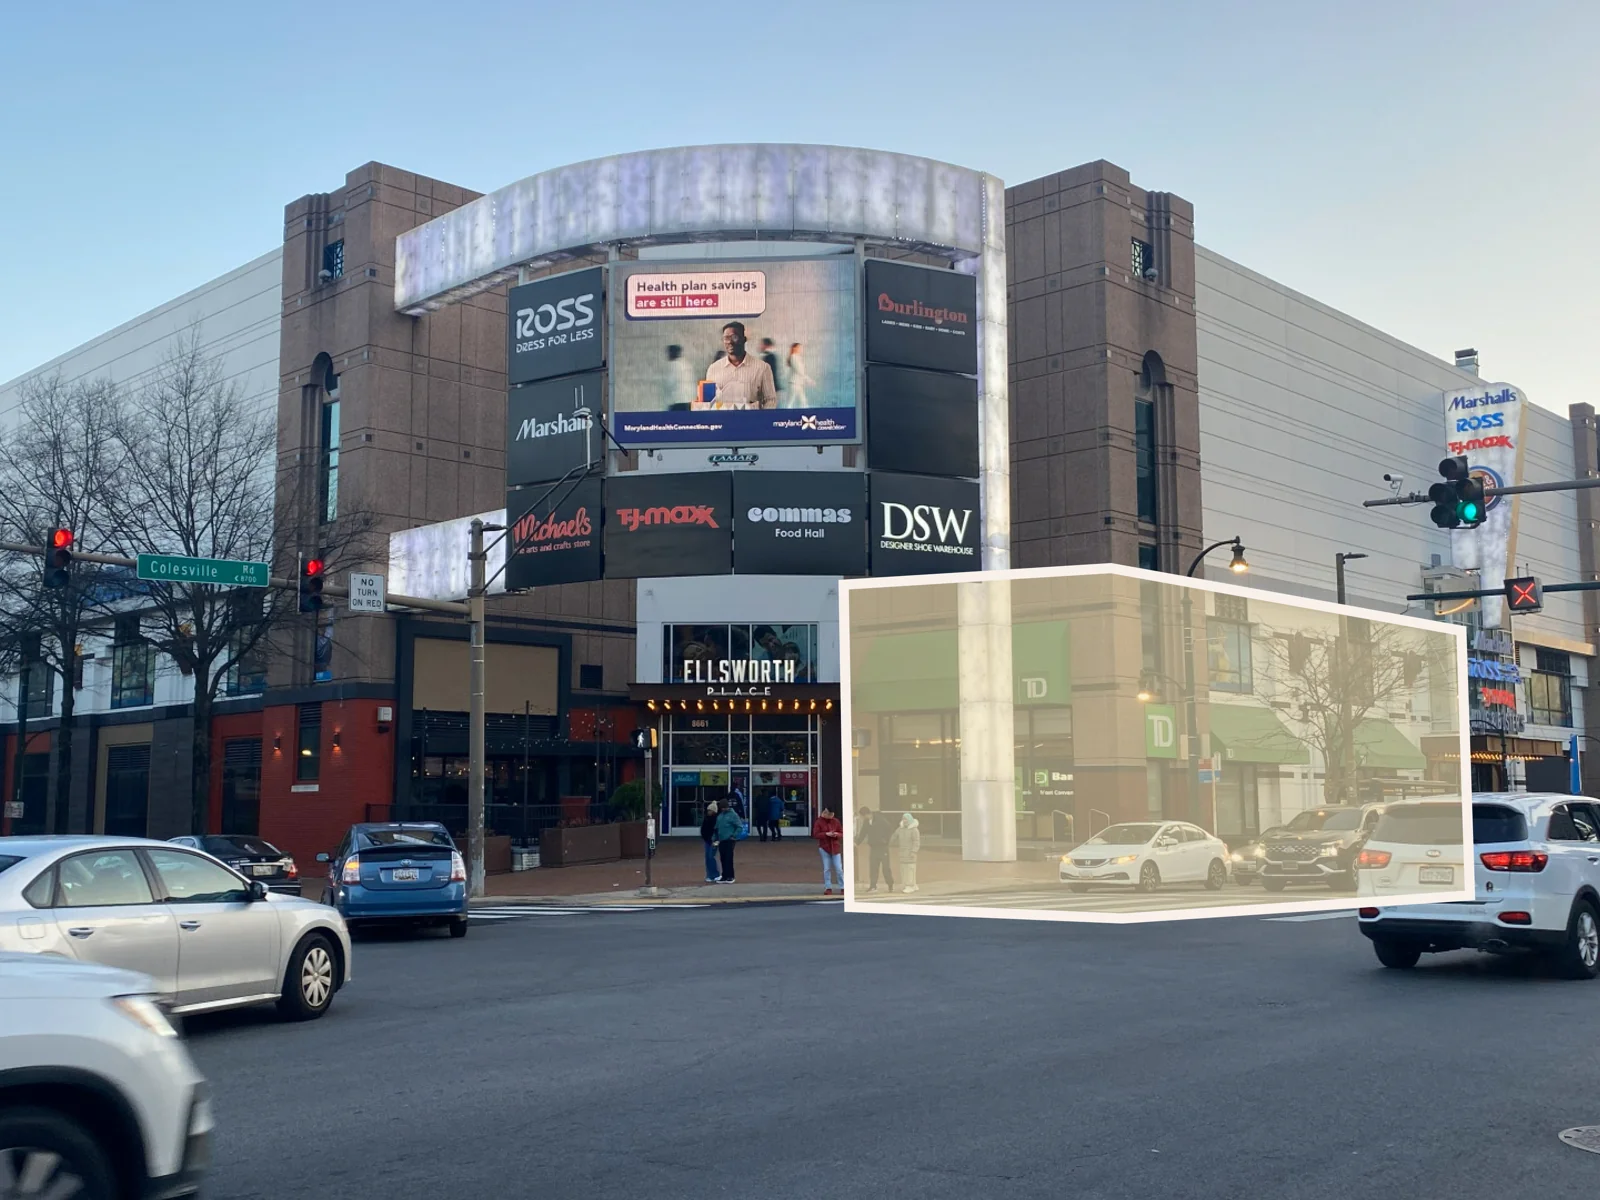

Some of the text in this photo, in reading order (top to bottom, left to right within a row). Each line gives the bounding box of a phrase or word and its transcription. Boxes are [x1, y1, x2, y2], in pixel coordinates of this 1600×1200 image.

[637, 279, 757, 293] Health plan savings
[636, 296, 717, 308] are still here.
[878, 293, 968, 325] Burlington
[516, 293, 594, 339] ROSS
[516, 328, 594, 353] DRESS FOR LESS
[1448, 388, 1517, 411] Marshalls
[773, 418, 835, 428] maryland health
[1456, 412, 1504, 432] ROSS
[747, 507, 852, 523] commas
[880, 501, 972, 544] DSW
[513, 506, 592, 544] Michaels
[775, 528, 825, 538] Food Hall
[540, 543, 552, 551] and
[553, 542, 571, 550] crafts
[573, 540, 591, 548] store
[880, 540, 974, 555] DESIGNER SHOE WAREHOUSE
[150, 560, 254, 577] Colesville Rd
[240, 575, 257, 583] 8700
[361, 578, 374, 587] NO
[357, 588, 378, 597] TURN
[366, 600, 382, 608] RED
[684, 659, 795, 683] ELLSWORTH
[707, 686, 771, 696] PLACE
[1021, 677, 1047, 699] TD
[1147, 714, 1174, 748] TD
[1052, 772, 1073, 781] Ban
